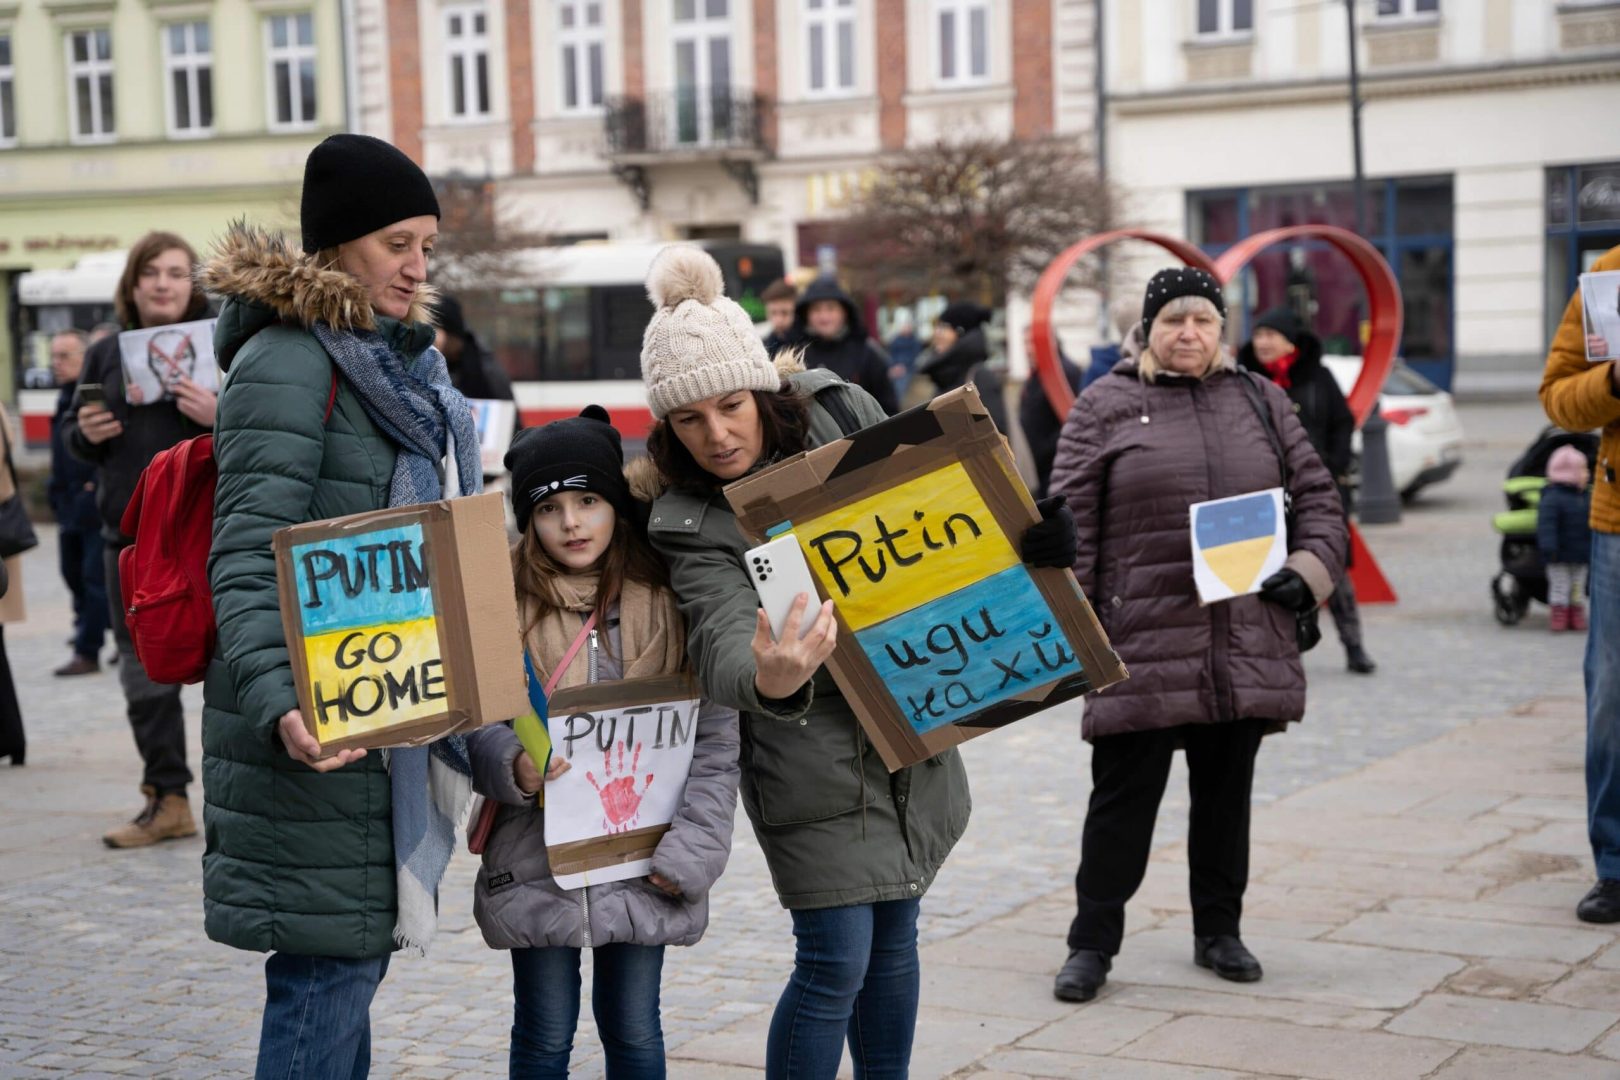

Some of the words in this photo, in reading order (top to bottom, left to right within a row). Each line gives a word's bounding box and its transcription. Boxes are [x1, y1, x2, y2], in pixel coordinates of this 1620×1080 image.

[302, 540, 430, 608] PUTIN
[809, 510, 982, 597] Putin
[334, 632, 403, 670] GO
[313, 659, 447, 725] HOME
[563, 703, 700, 759] PUTIN
